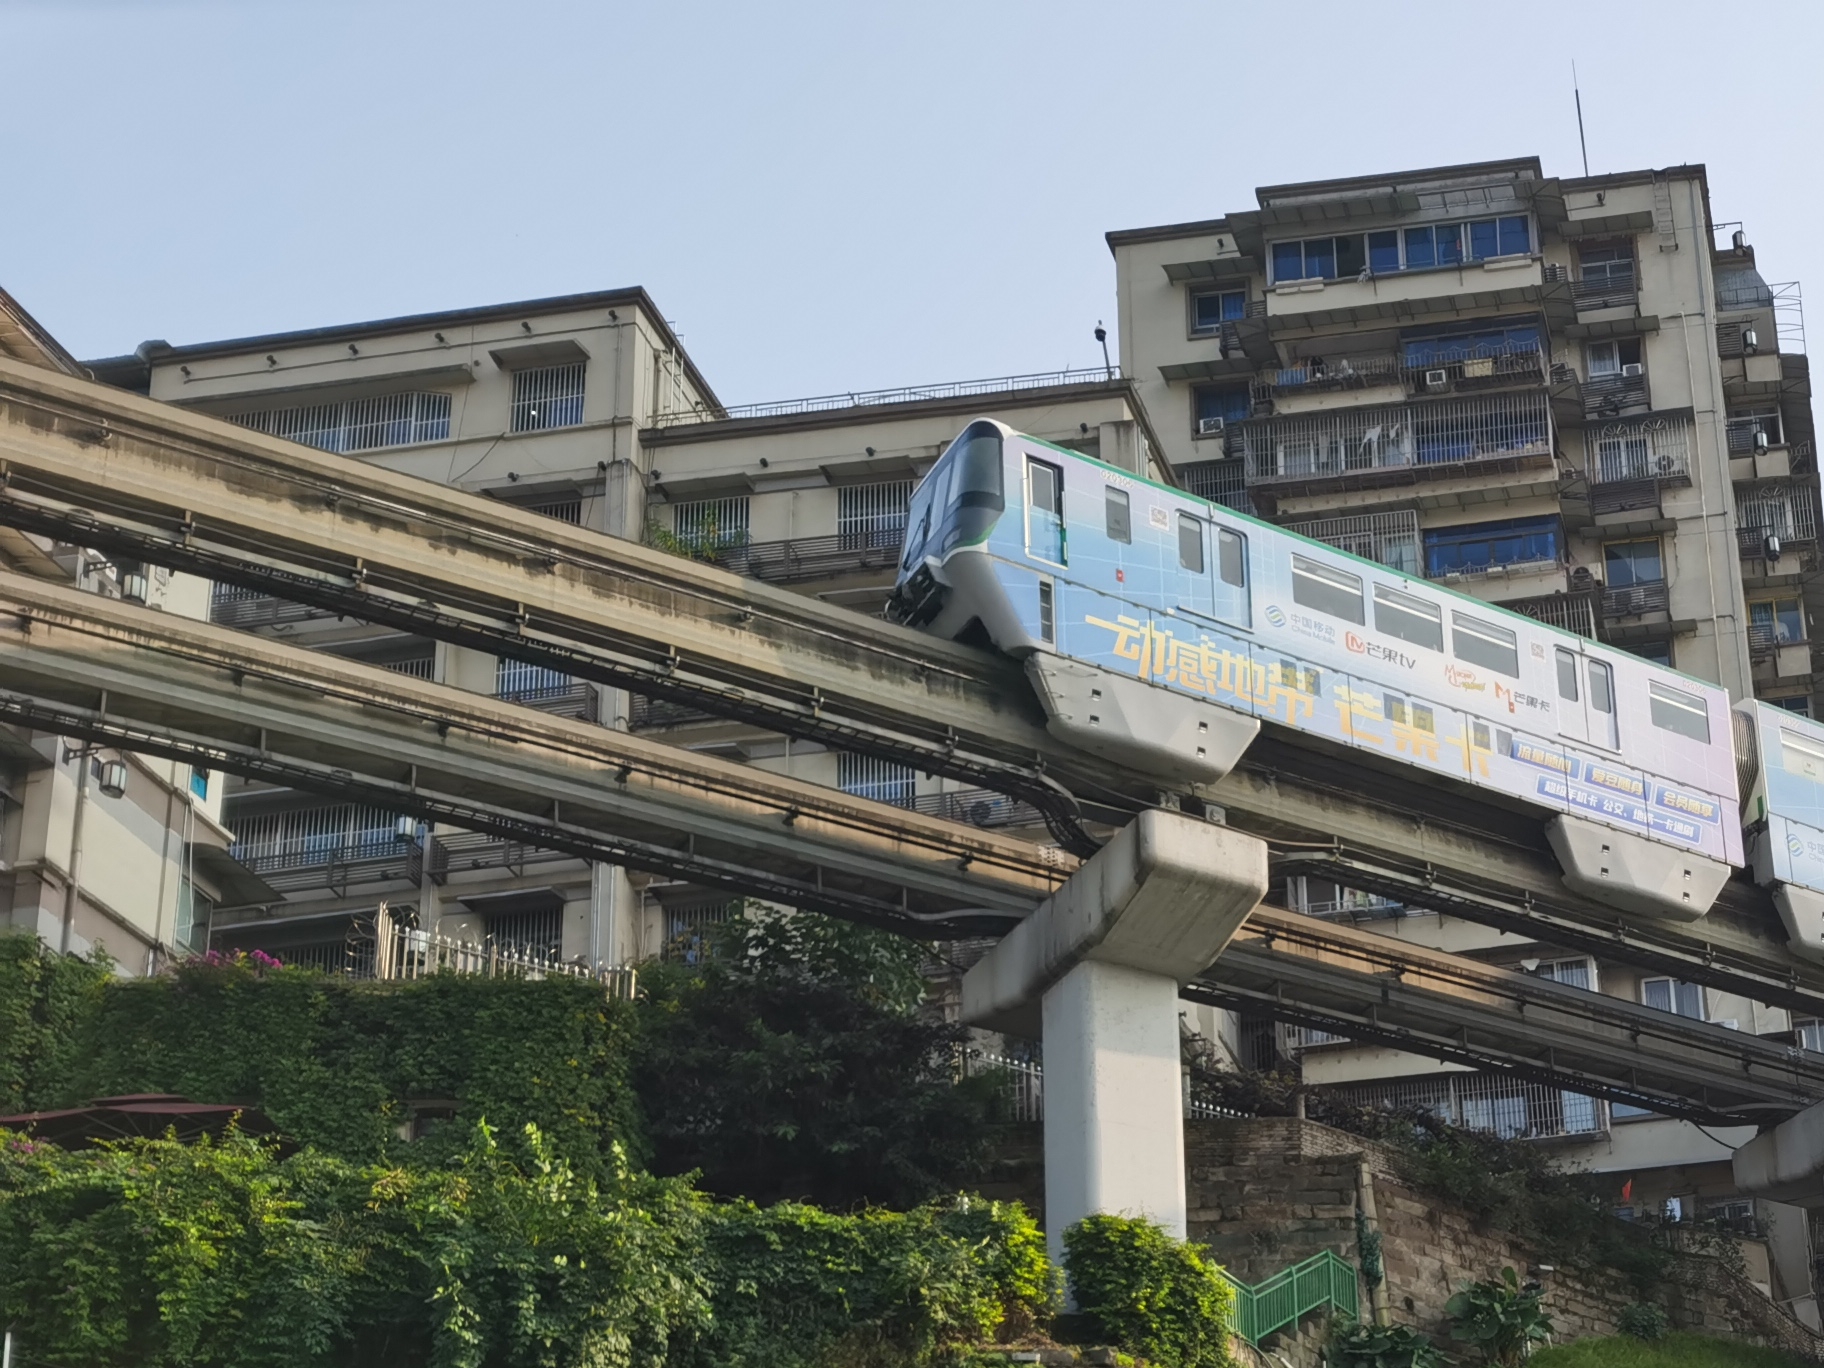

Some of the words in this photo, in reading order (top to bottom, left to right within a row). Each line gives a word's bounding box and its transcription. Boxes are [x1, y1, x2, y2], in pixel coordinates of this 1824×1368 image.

[1290, 612, 1336, 637] 中国移动
[1514, 691, 1551, 713] 芒果卡
[1334, 684, 1494, 779] 芒果卡
